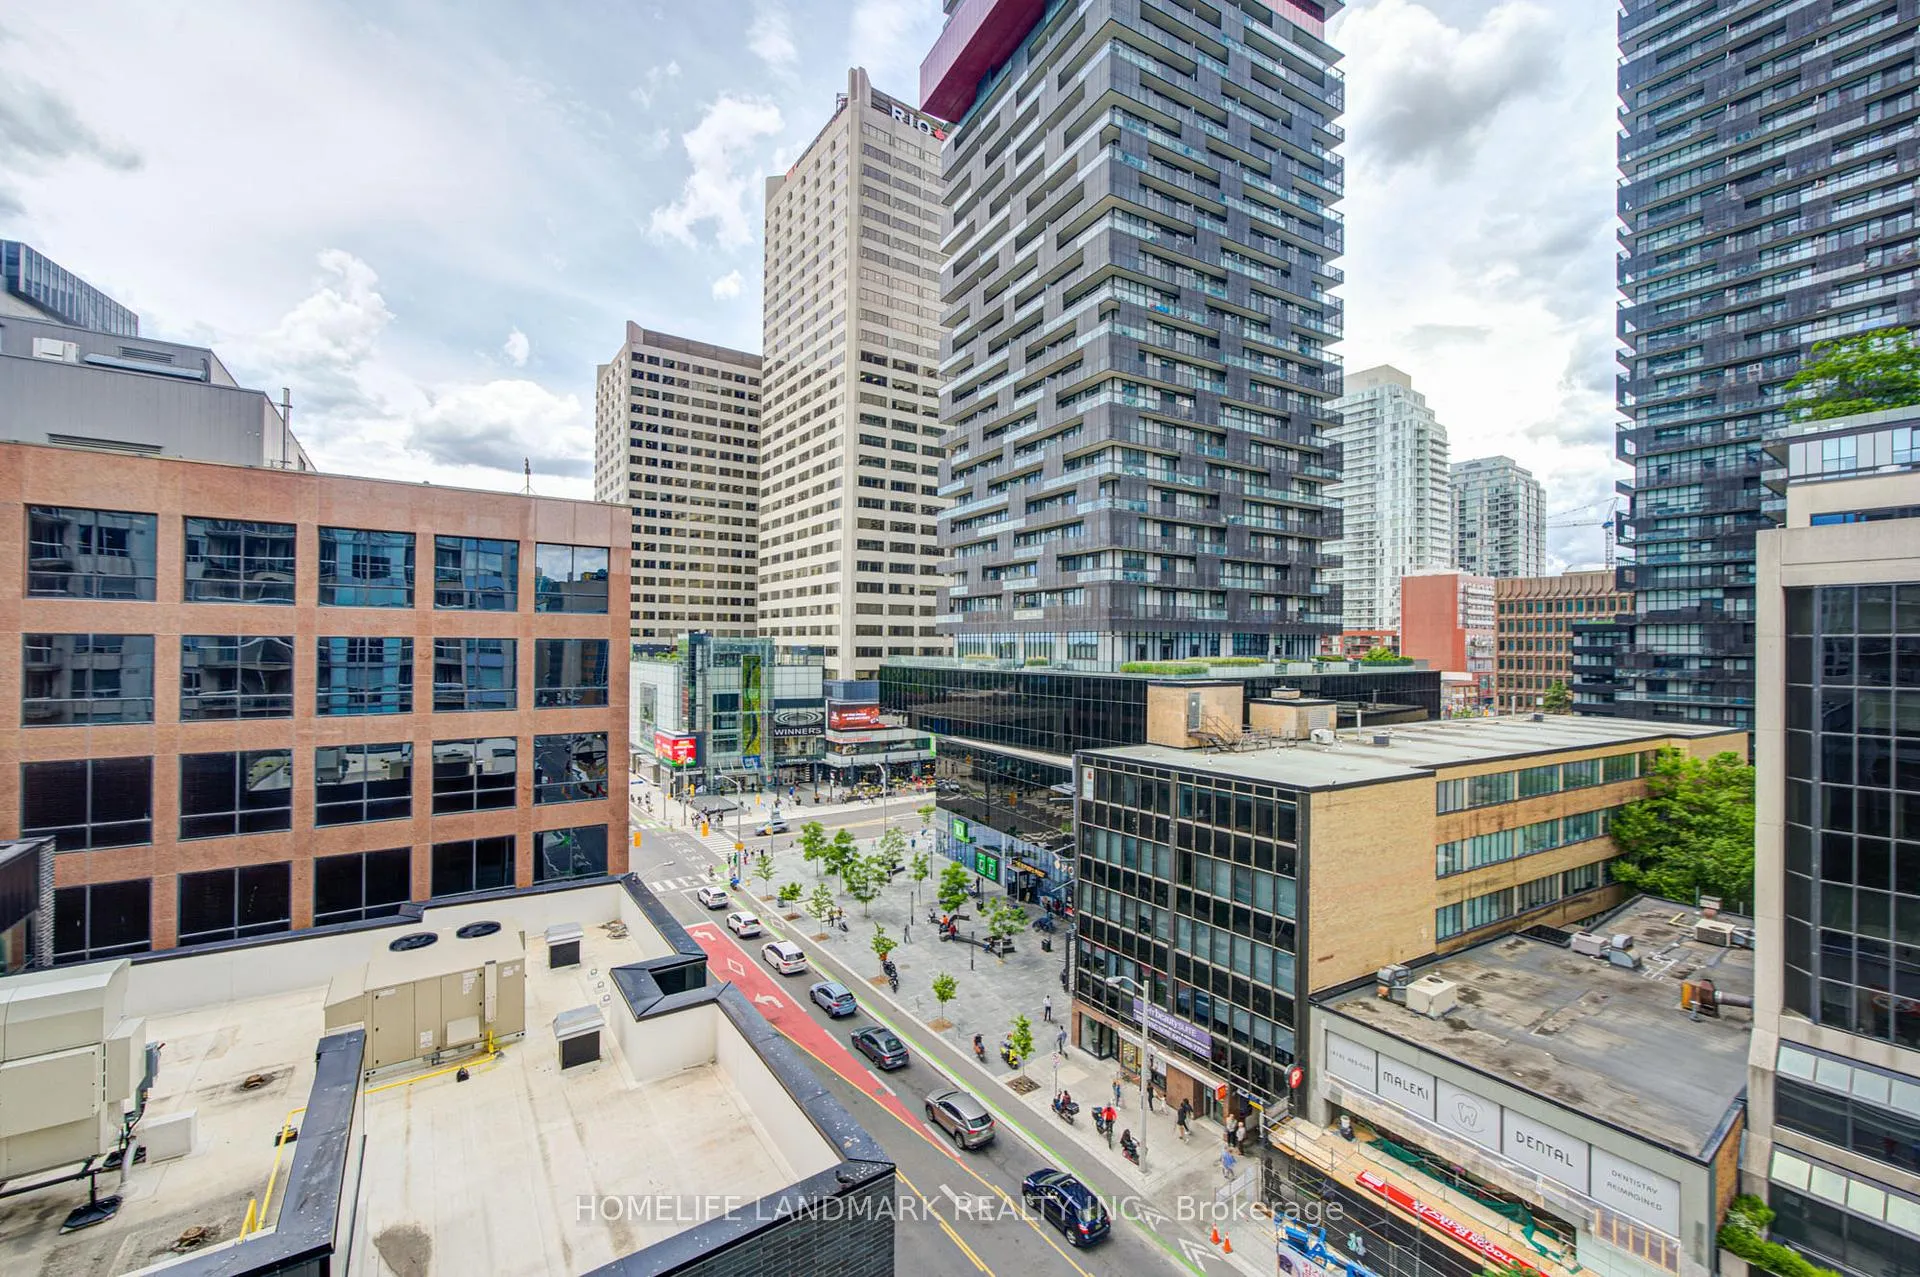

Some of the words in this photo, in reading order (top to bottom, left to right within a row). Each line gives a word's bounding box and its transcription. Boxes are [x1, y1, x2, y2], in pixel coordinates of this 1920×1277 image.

[774, 727, 822, 735] WINNERS
[1383, 1071, 1429, 1101] MALEKI
[1515, 1130, 1574, 1168] DENTAL
[1606, 1180, 1662, 1211] REIMAGINED
[1611, 1169, 1658, 1194] DENTISTRY
